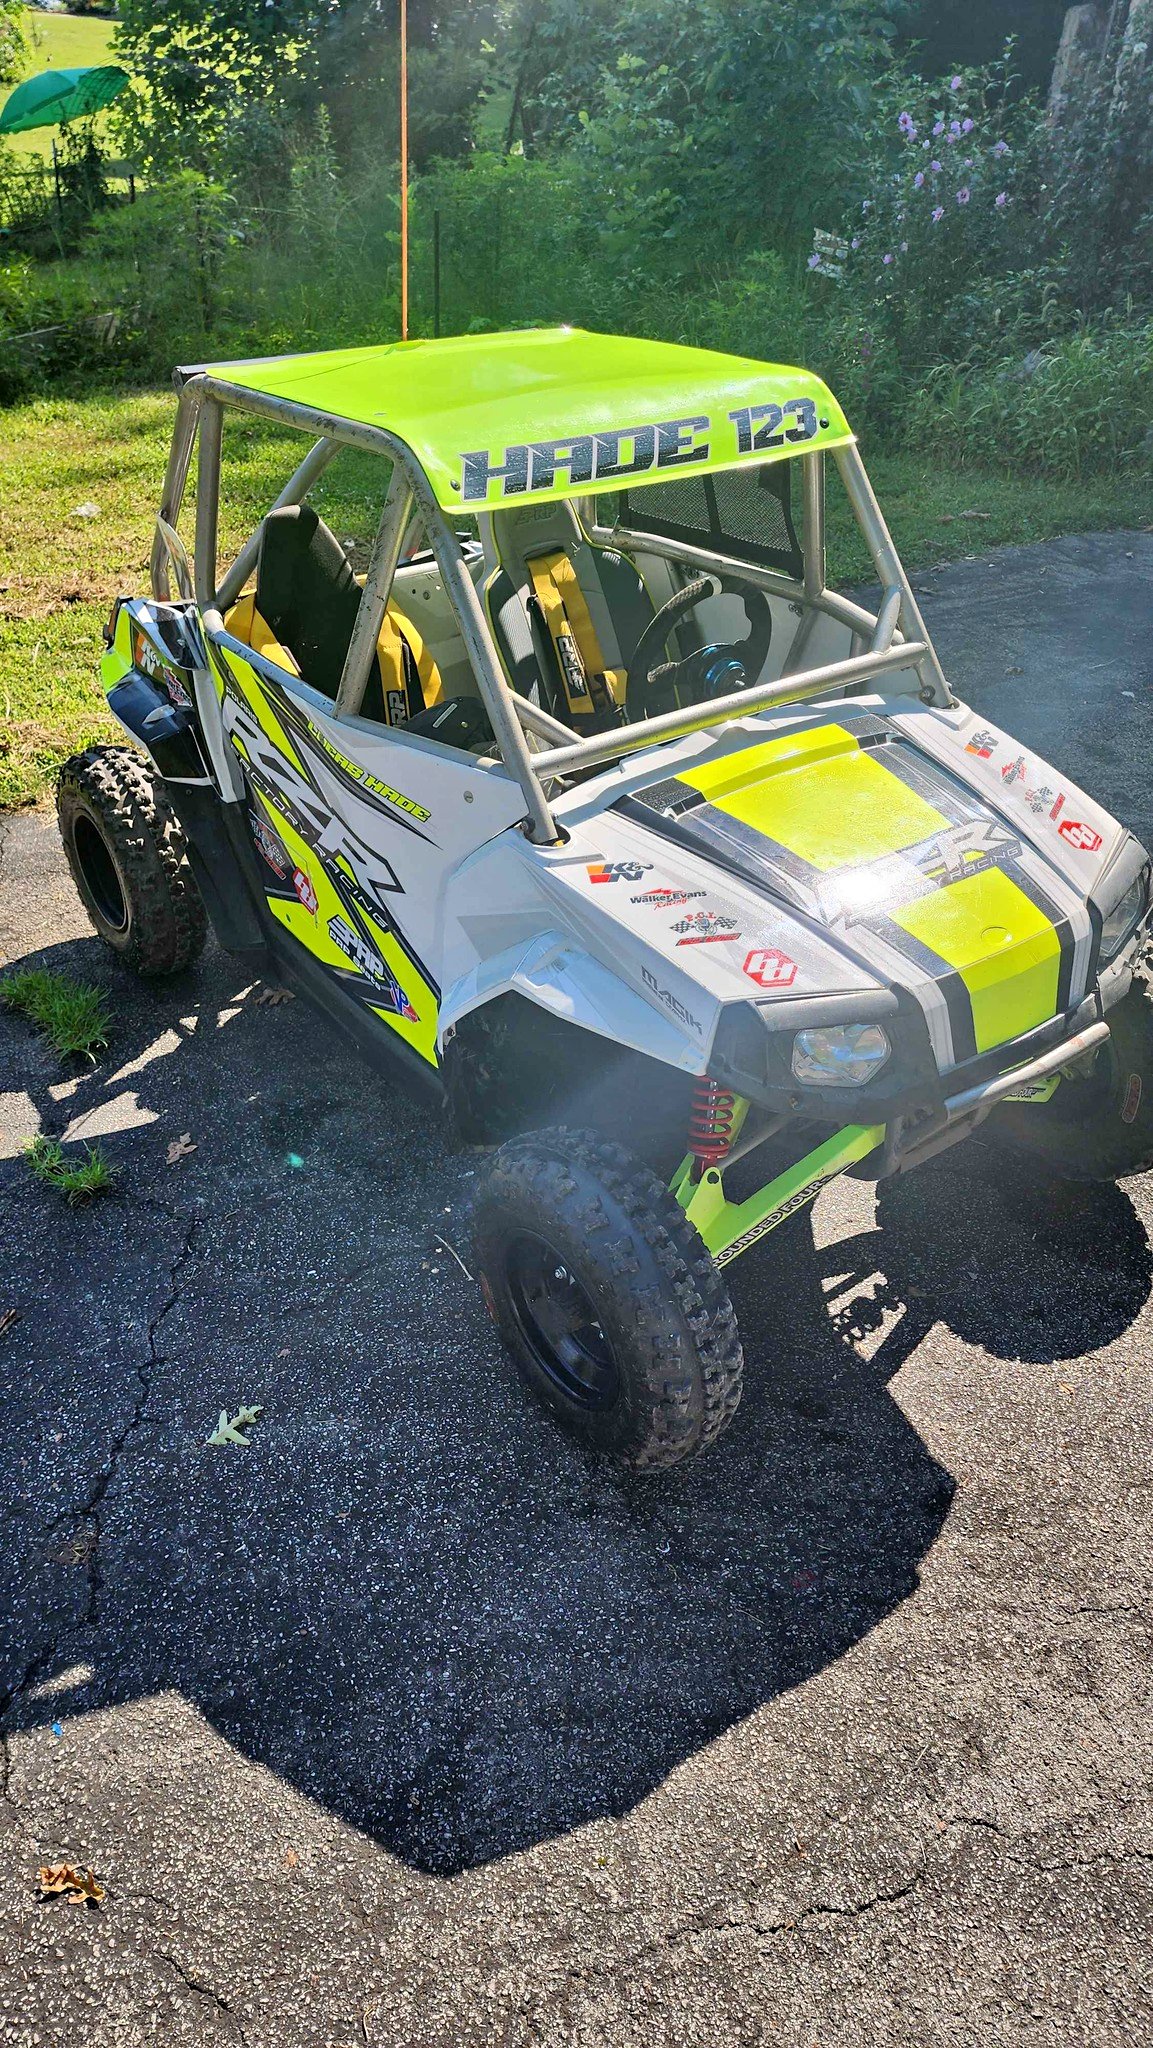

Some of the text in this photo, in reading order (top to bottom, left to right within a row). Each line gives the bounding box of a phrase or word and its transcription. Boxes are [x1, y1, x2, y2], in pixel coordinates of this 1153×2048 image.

[459, 396, 818, 503] HADE 123
[225, 685, 259, 725] POLARIS
[307, 720, 432, 823] LUCAS HADE
[221, 693, 399, 912] RZR
[602, 861, 655, 883] K&N
[949, 845, 1020, 880] RACING
[312, 843, 389, 928] RACING
[629, 890, 708, 904] Walker Evans
[780, 1180, 823, 1213] FOUR
